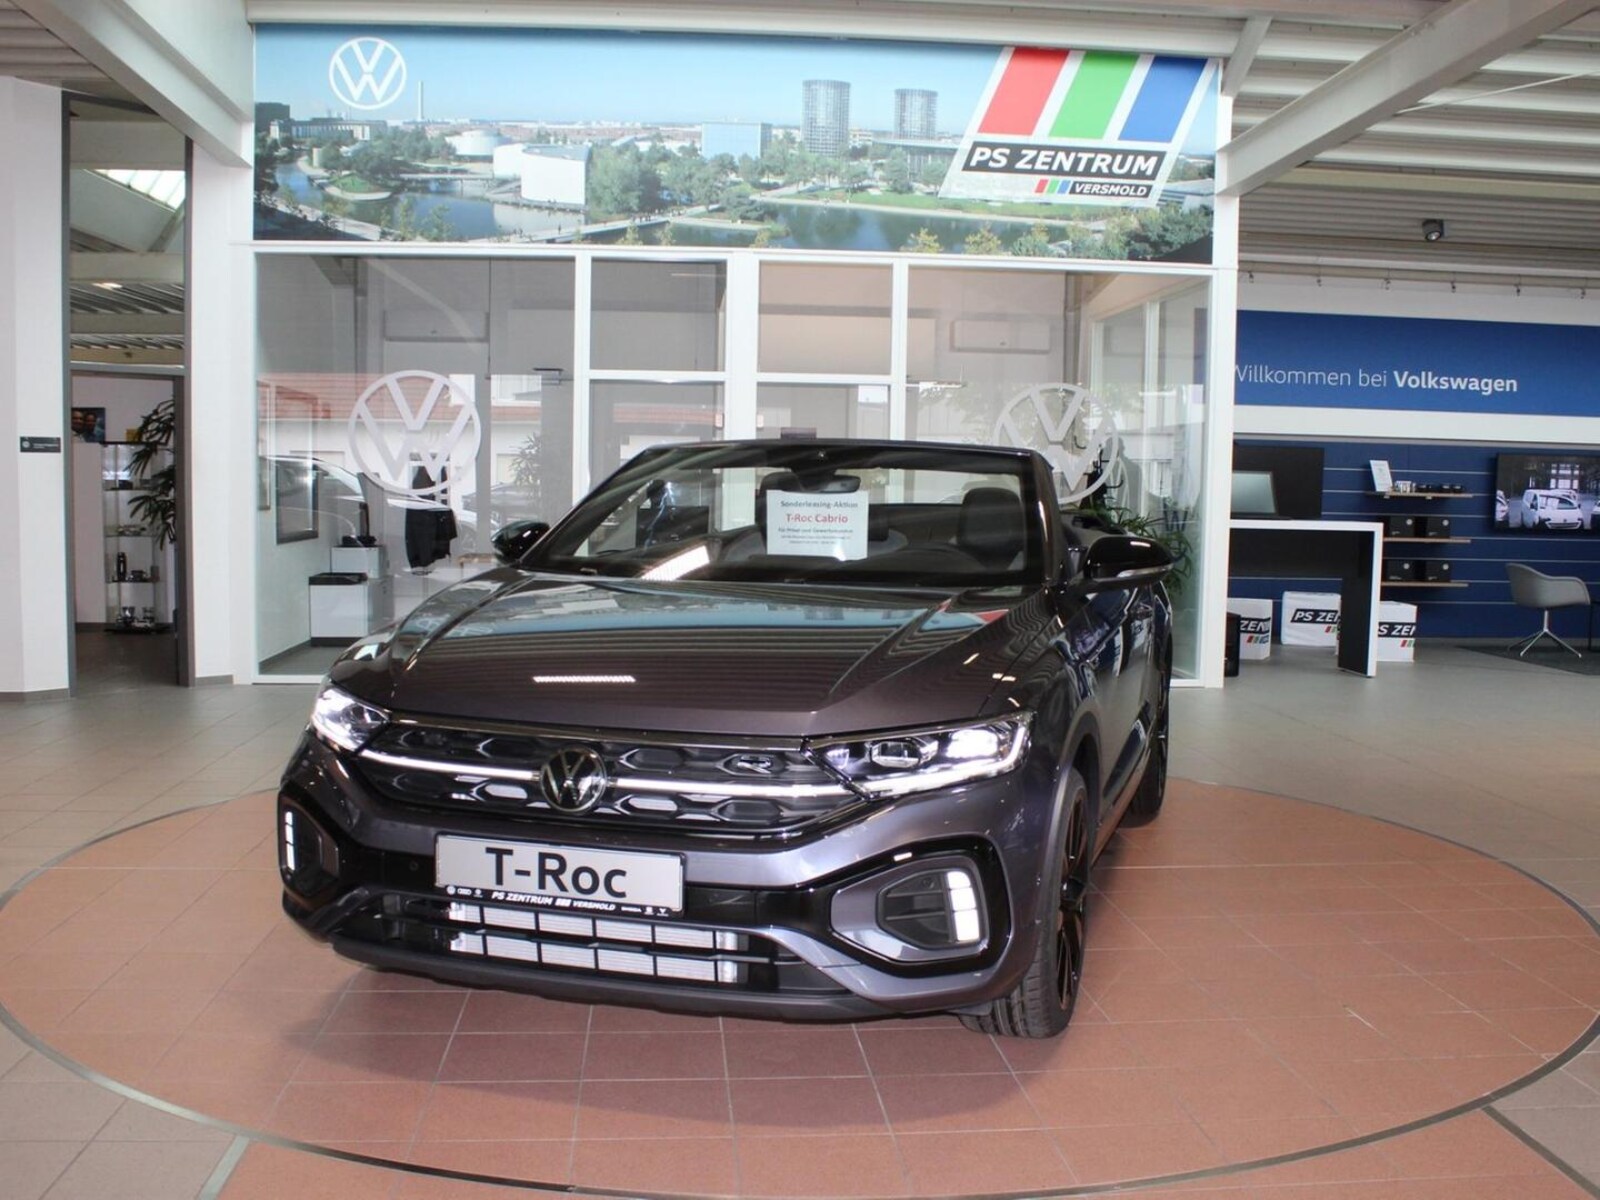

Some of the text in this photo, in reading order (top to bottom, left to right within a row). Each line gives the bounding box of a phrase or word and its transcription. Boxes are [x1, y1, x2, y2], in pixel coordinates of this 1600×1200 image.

[969, 147, 1158, 176] PS ZENTRUM
[1074, 183, 1148, 197] VERSMOLD
[1358, 368, 1387, 388] bei
[1393, 370, 1518, 396] Volkswagen
[786, 513, 849, 524] T-Roc Cabrio
[1294, 611, 1314, 622] PS
[1378, 624, 1389, 636] S
[485, 846, 628, 899] T-Roc
[491, 891, 506, 901] PS
[506, 893, 554, 906] ZENTRUM
[572, 900, 616, 911] VERSMOLD
